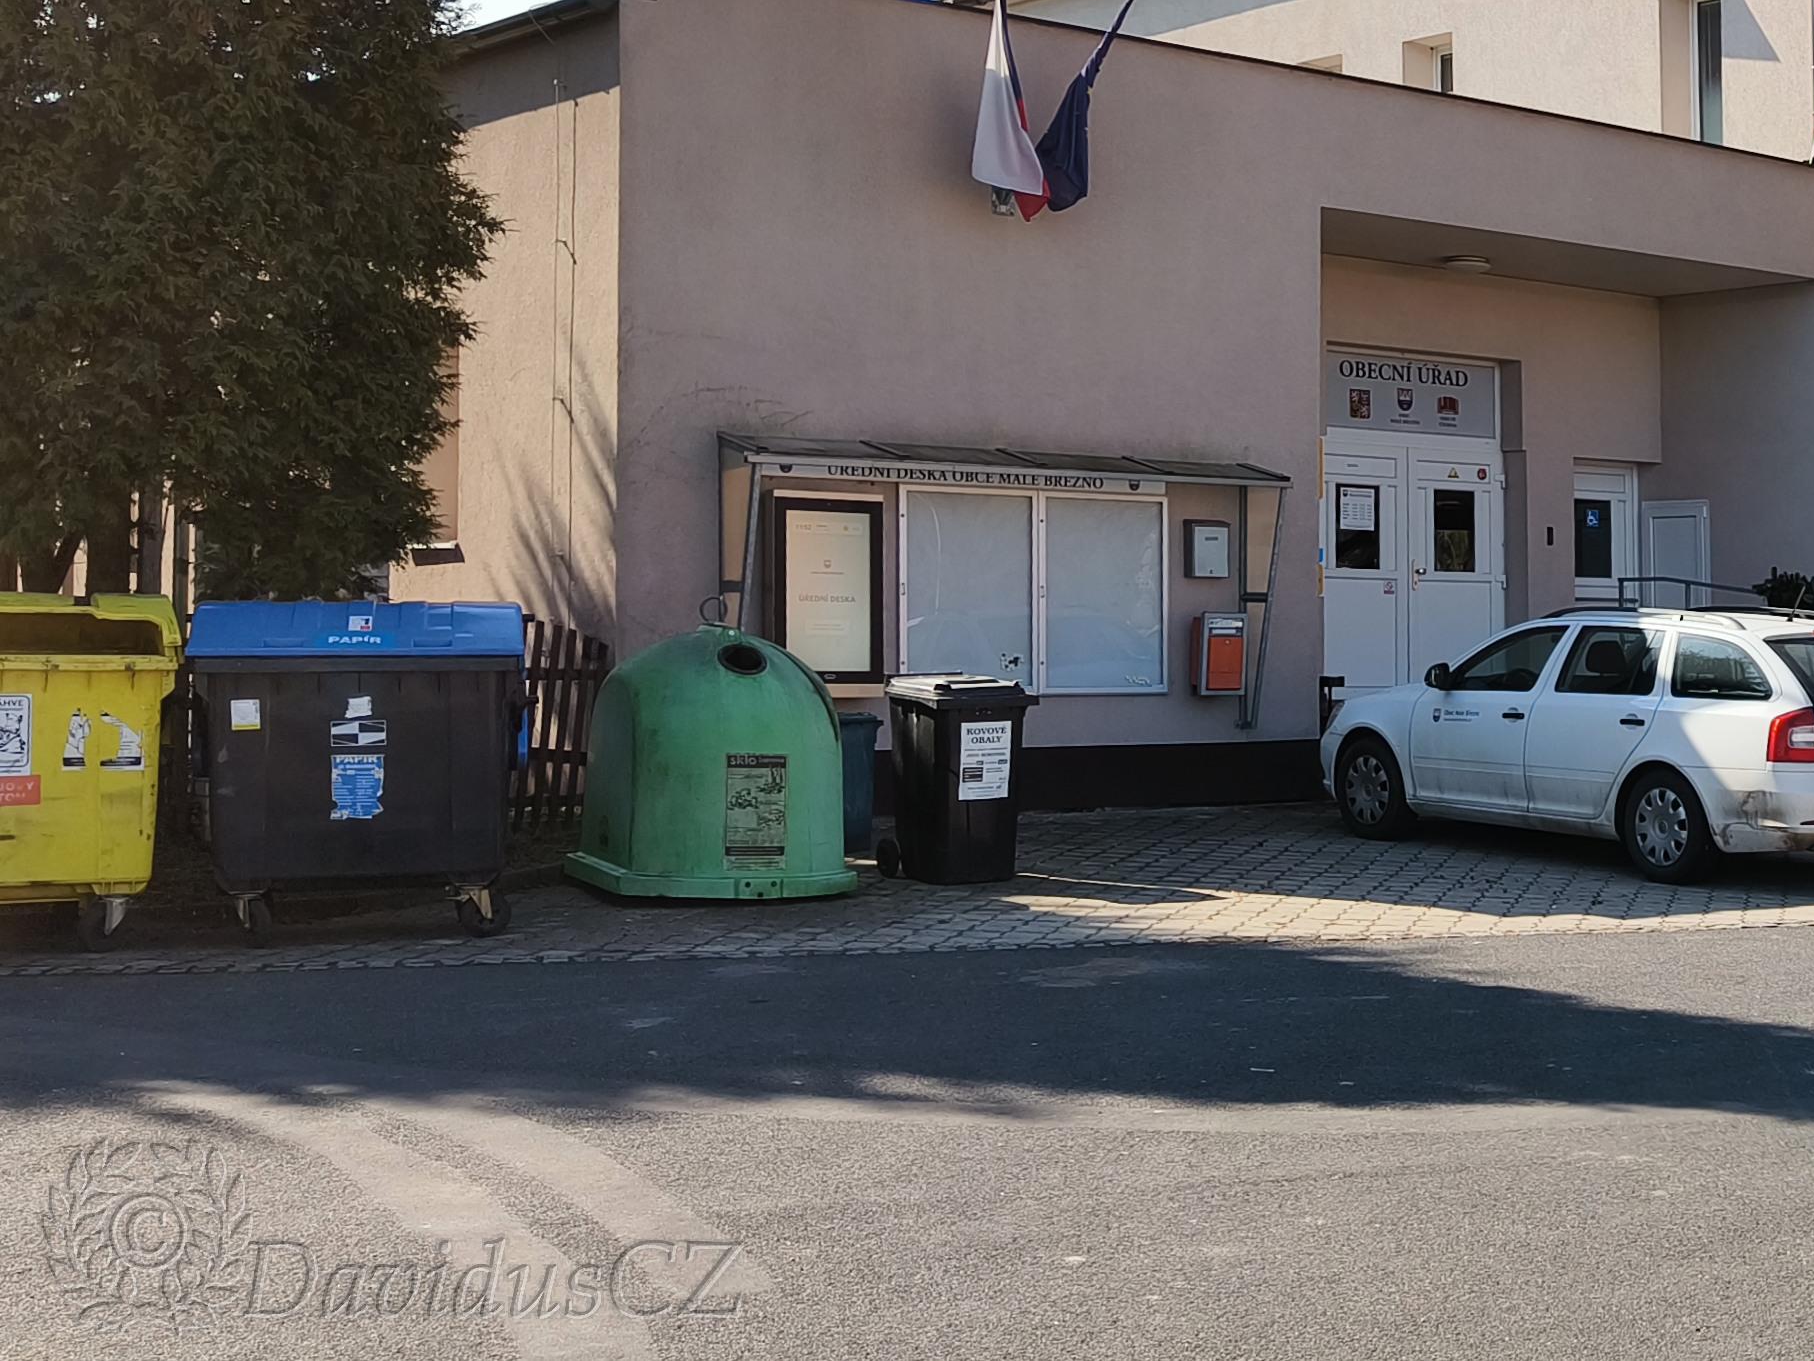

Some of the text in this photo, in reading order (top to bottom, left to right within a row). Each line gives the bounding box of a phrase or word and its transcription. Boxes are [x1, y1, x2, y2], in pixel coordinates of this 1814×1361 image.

[1339, 360, 1469, 387] OBECNÍ ÚŘAD
[896, 468, 948, 482] DESKA
[952, 471, 995, 484] OBCE
[830, 595, 856, 603] DESKA
[327, 635, 382, 644] PAPÍR
[971, 735, 1002, 744] OBALY
[729, 755, 758, 765] sklo
